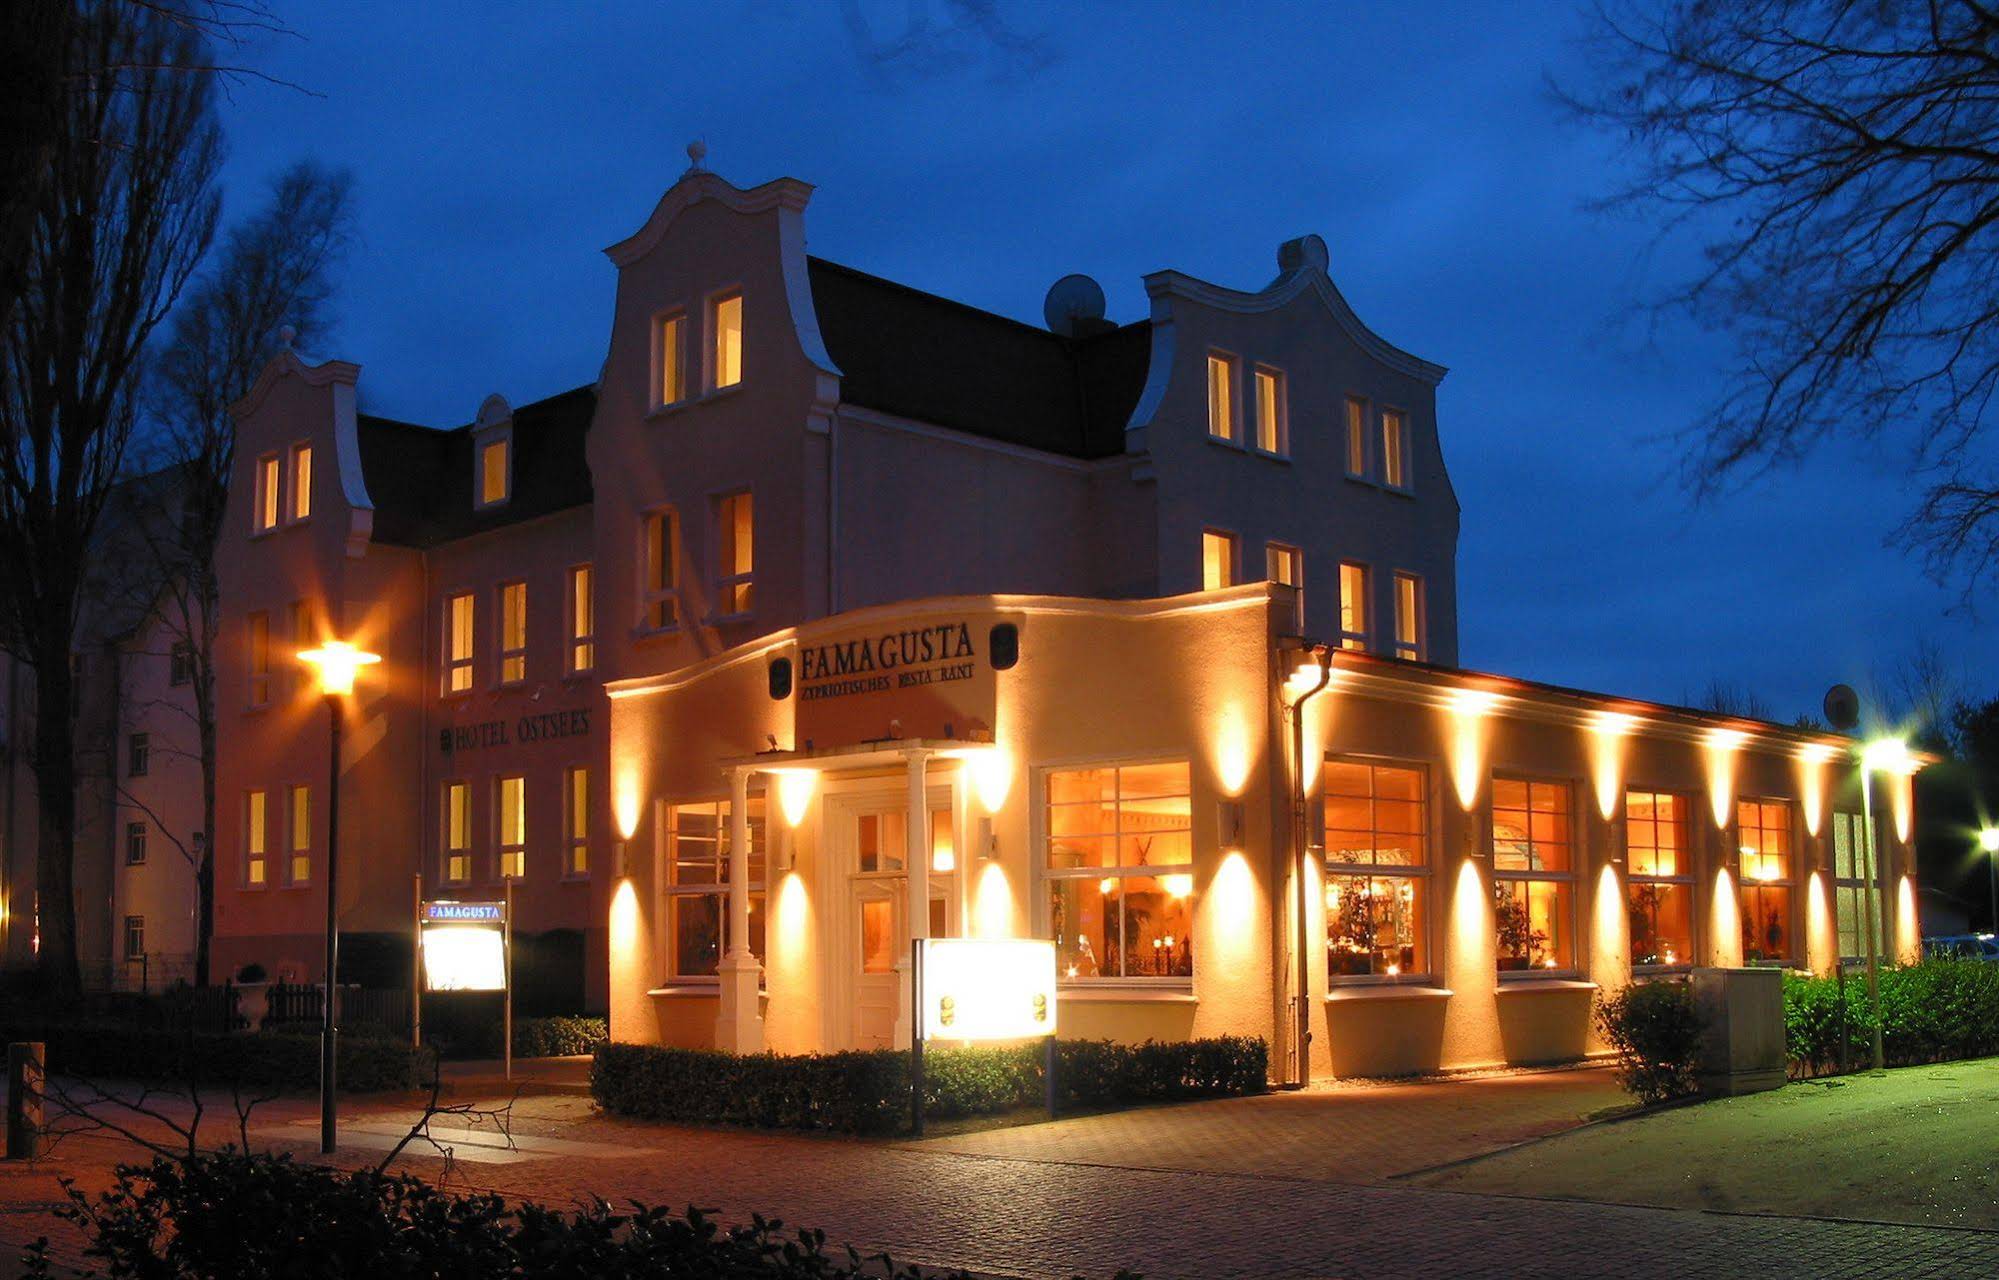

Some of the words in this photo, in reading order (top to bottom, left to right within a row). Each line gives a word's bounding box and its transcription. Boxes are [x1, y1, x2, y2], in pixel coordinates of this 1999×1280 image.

[801, 622, 975, 681] FAMAGUSTA
[898, 663, 976, 690] RESTARANT
[455, 720, 511, 752] HOTEL
[429, 905, 499, 918] FAMAGUSTA
